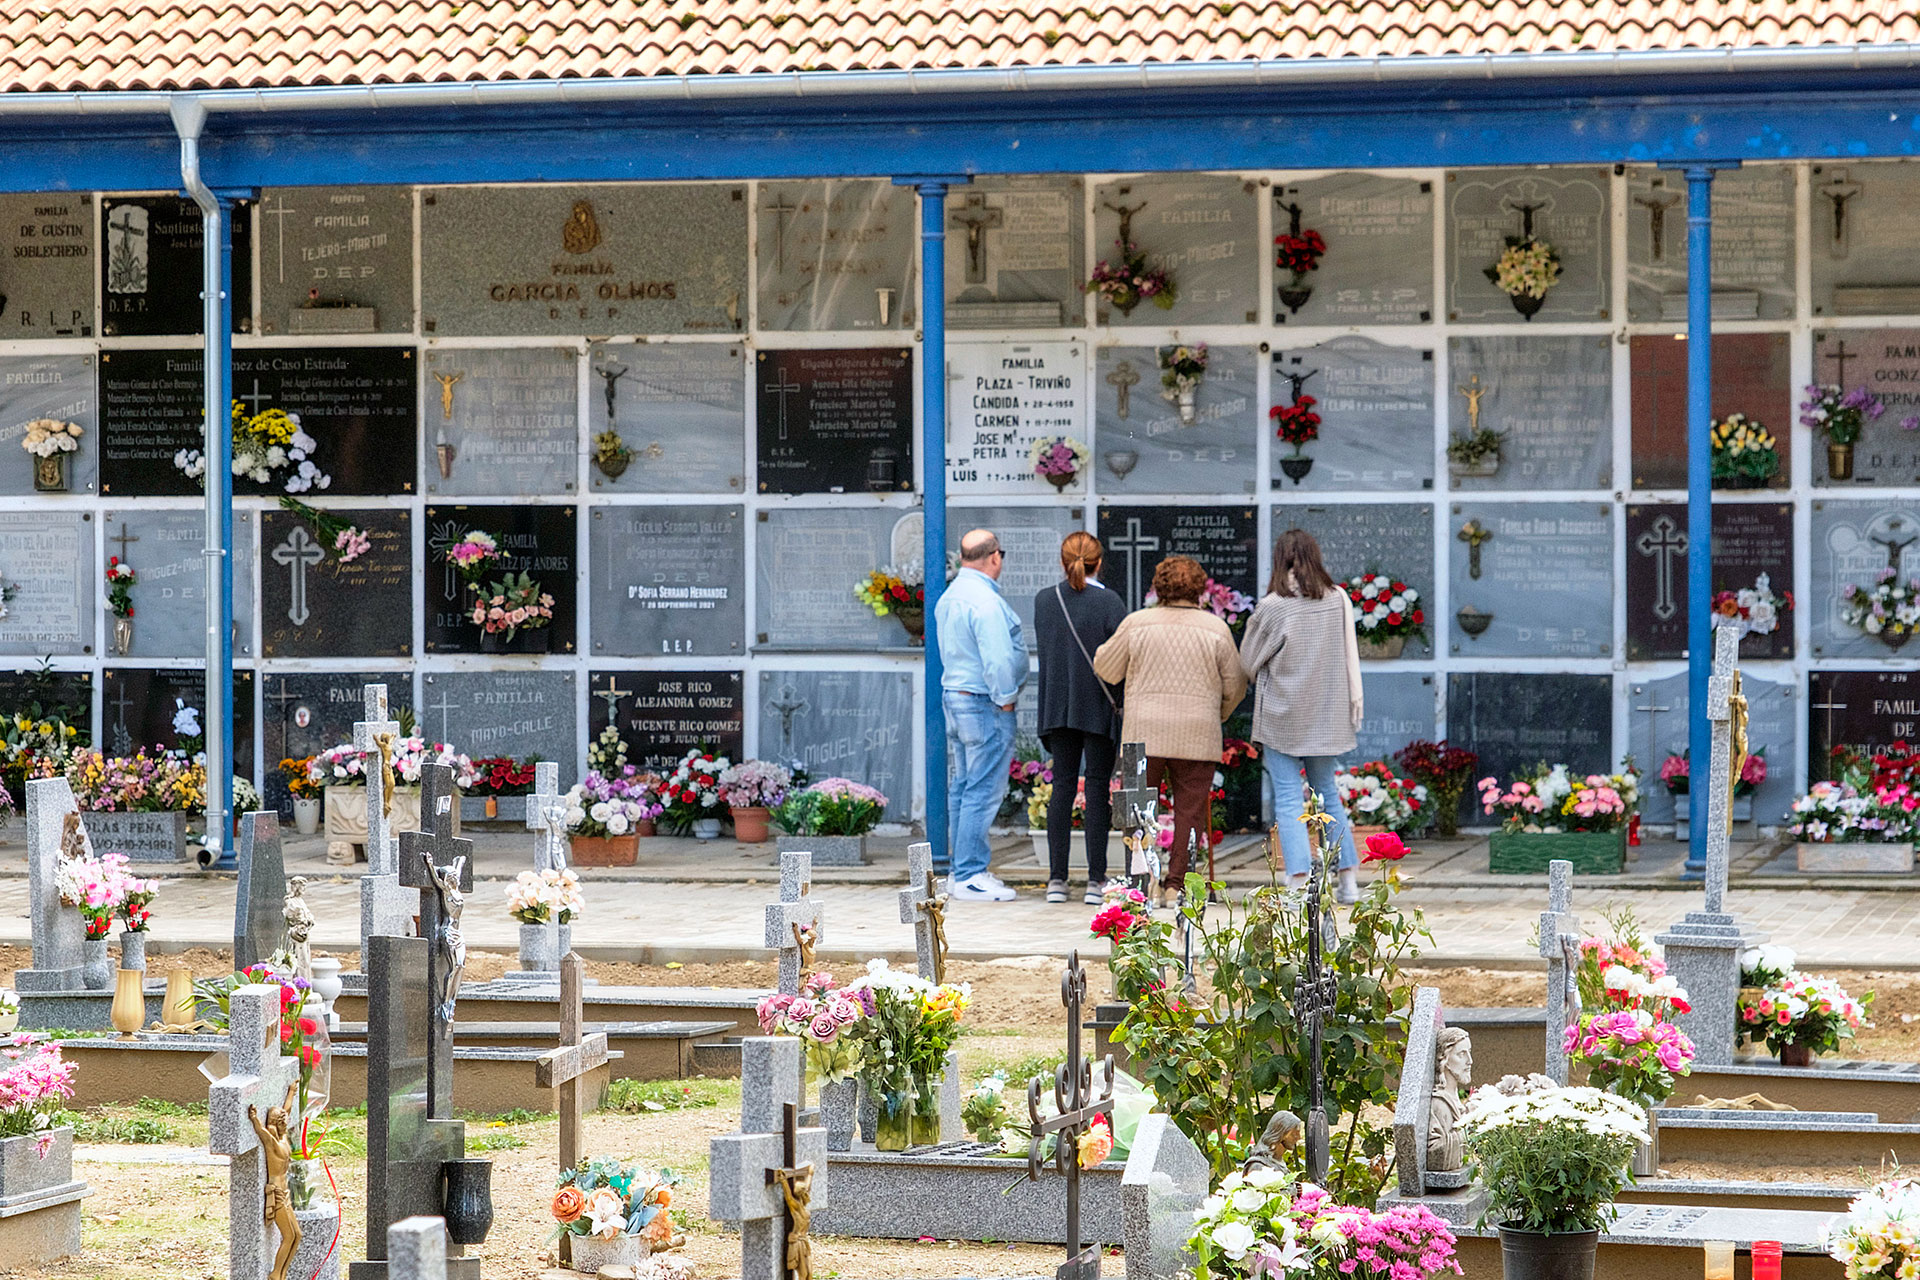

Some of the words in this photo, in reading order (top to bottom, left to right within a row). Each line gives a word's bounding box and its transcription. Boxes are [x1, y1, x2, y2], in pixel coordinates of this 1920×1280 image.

[315, 214, 369, 227] FAMILIA
[1161, 209, 1232, 224] FAMILIA
[20, 225, 36, 238] DE
[13, 245, 89, 258] SOBLECHERO
[552, 264, 615, 276] FAMILIA
[490, 283, 581, 302] GARCIA
[166, 359, 205, 371] Famili
[255, 359, 270, 371] de
[272, 359, 301, 372] Caso
[304, 359, 347, 372] Estrada
[1002, 358, 1045, 370] FAMILIA
[6, 372, 63, 384] FAMILIA
[976, 376, 1013, 390] PLAZA
[1028, 374, 1071, 390] TRIVIÑO
[973, 395, 1020, 410] CANDIDA
[45, 400, 88, 421] GONZALEZ
[975, 414, 1020, 428] CARMEN
[973, 431, 999, 445] JOSE
[973, 448, 1007, 459] PETRA
[953, 471, 978, 482] LUIS
[1177, 515, 1230, 527] FAMILIA
[157, 529, 205, 541] FAMIL
[503, 534, 538, 548] FAMILIA
[519, 556, 531, 571] DE
[533, 556, 569, 571] ANDRES
[638, 585, 659, 599] SOFIA
[659, 585, 690, 599] SERRANO
[689, 585, 728, 599] HERNANDEZ
[657, 681, 683, 694] JOSE
[687, 681, 713, 694] RICO
[329, 688, 365, 702] FAMI
[473, 691, 545, 704] FAMILIA
[635, 697, 694, 709] ALEJANDRA
[698, 697, 734, 709] GOMEZ
[471, 716, 553, 744] MAYO-CALLE
[631, 719, 676, 731] VICENTE
[679, 719, 704, 731] RICO
[705, 719, 741, 731] GOMEZ
[1894, 720, 1916, 737] DE
[674, 734, 699, 744] JULIO
[702, 734, 721, 744] 1971
[804, 723, 899, 767] MIGUEL-SANZ
[660, 755, 679, 768] DEL
